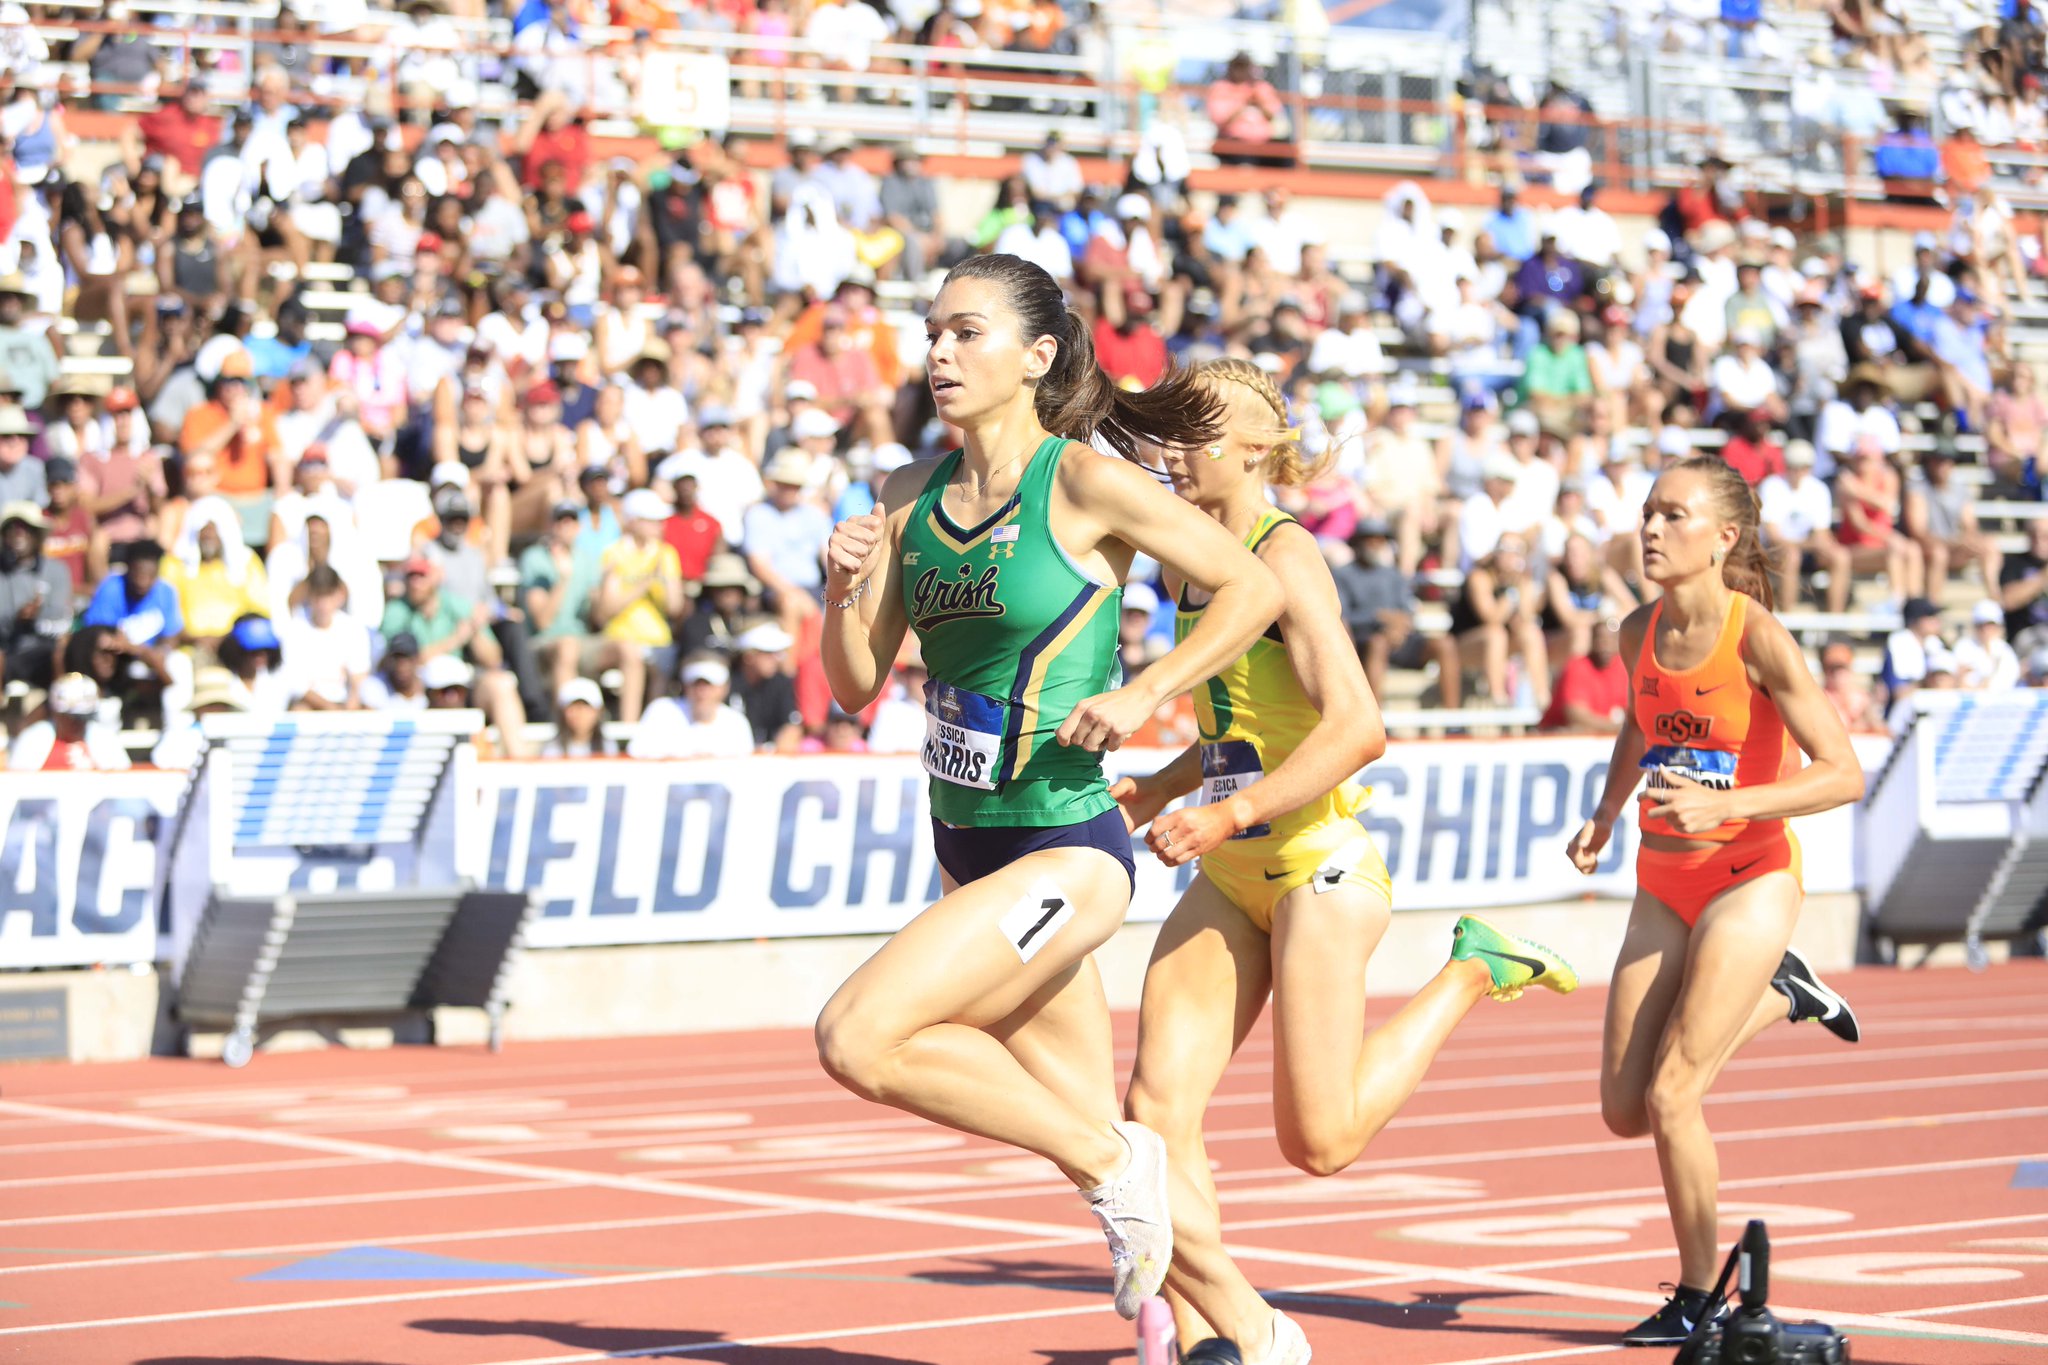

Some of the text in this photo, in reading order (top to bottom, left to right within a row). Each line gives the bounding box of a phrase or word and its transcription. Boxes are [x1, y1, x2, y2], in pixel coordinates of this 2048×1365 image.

[674, 64, 698, 113] 5
[910, 563, 1006, 632] Irish
[1655, 710, 1712, 745] OSU
[0, 798, 170, 937] AC
[485, 781, 732, 918] IELD
[1017, 898, 1065, 950] 1
